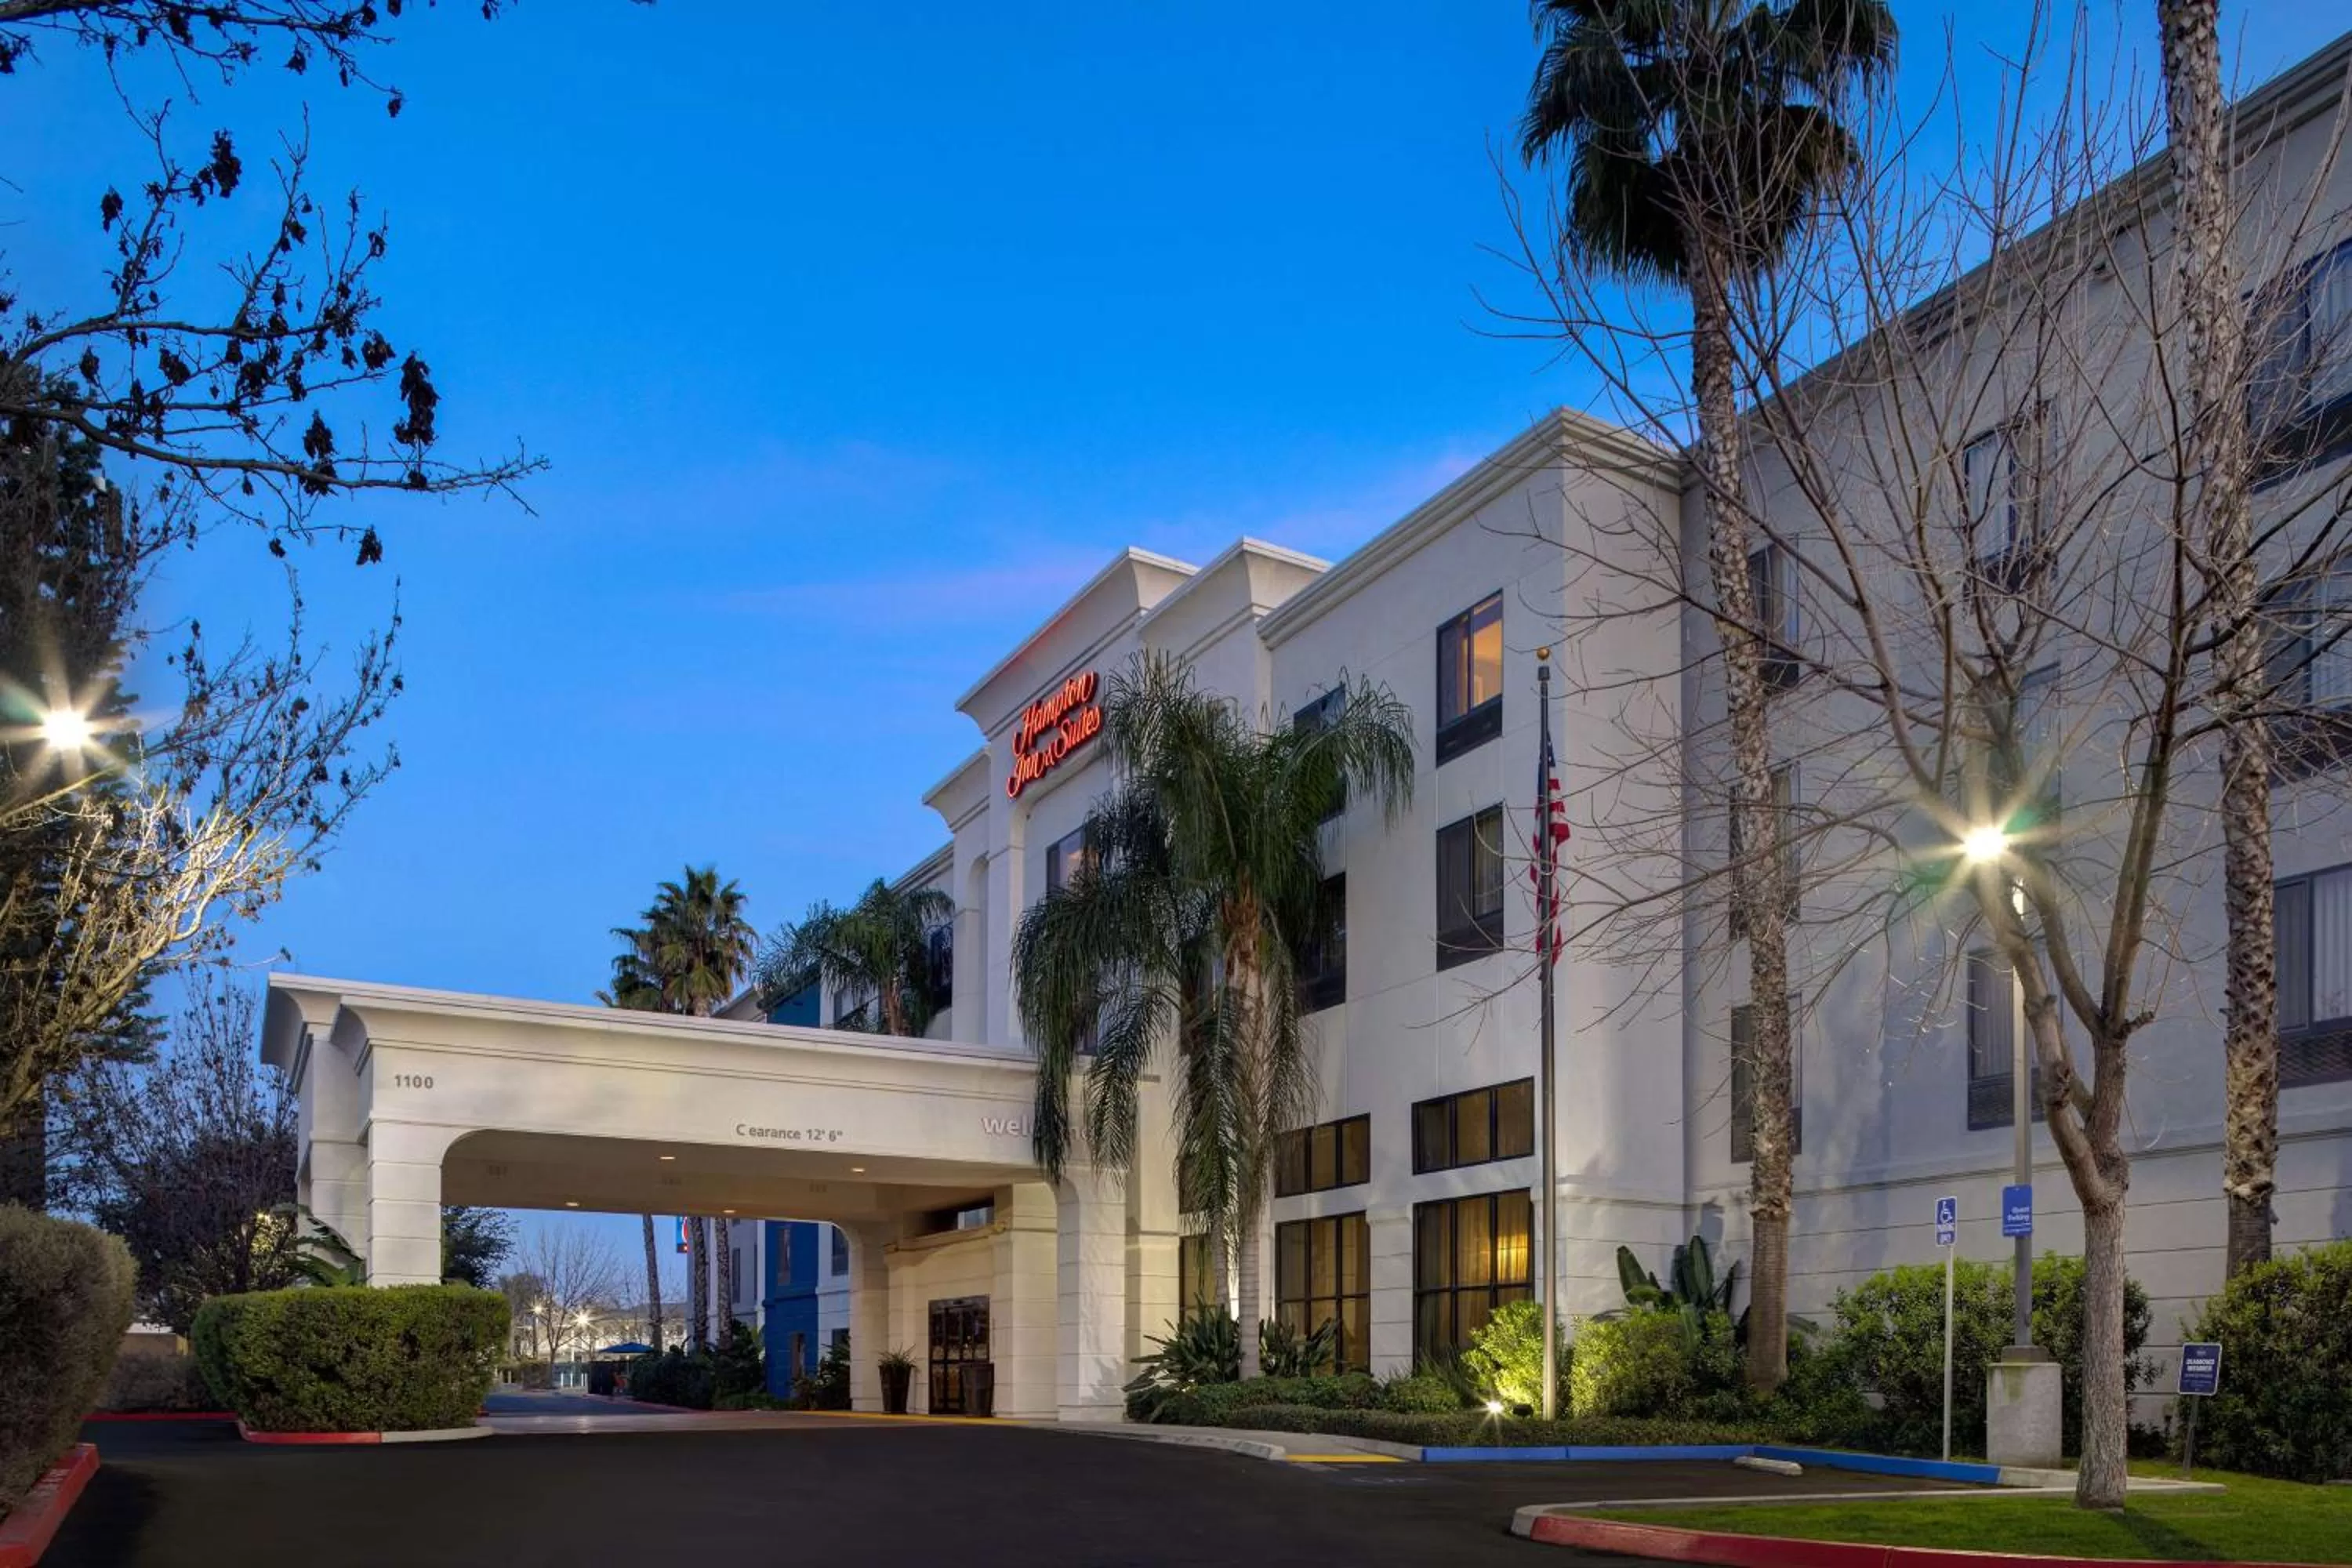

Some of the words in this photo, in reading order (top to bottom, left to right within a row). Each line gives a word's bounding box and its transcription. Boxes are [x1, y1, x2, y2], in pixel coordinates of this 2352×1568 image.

[1006, 752, 1045, 799] Inn
[1054, 706, 1102, 759] Suites
[1012, 670, 1097, 758] Hampton
[394, 1074, 434, 1089] 1100
